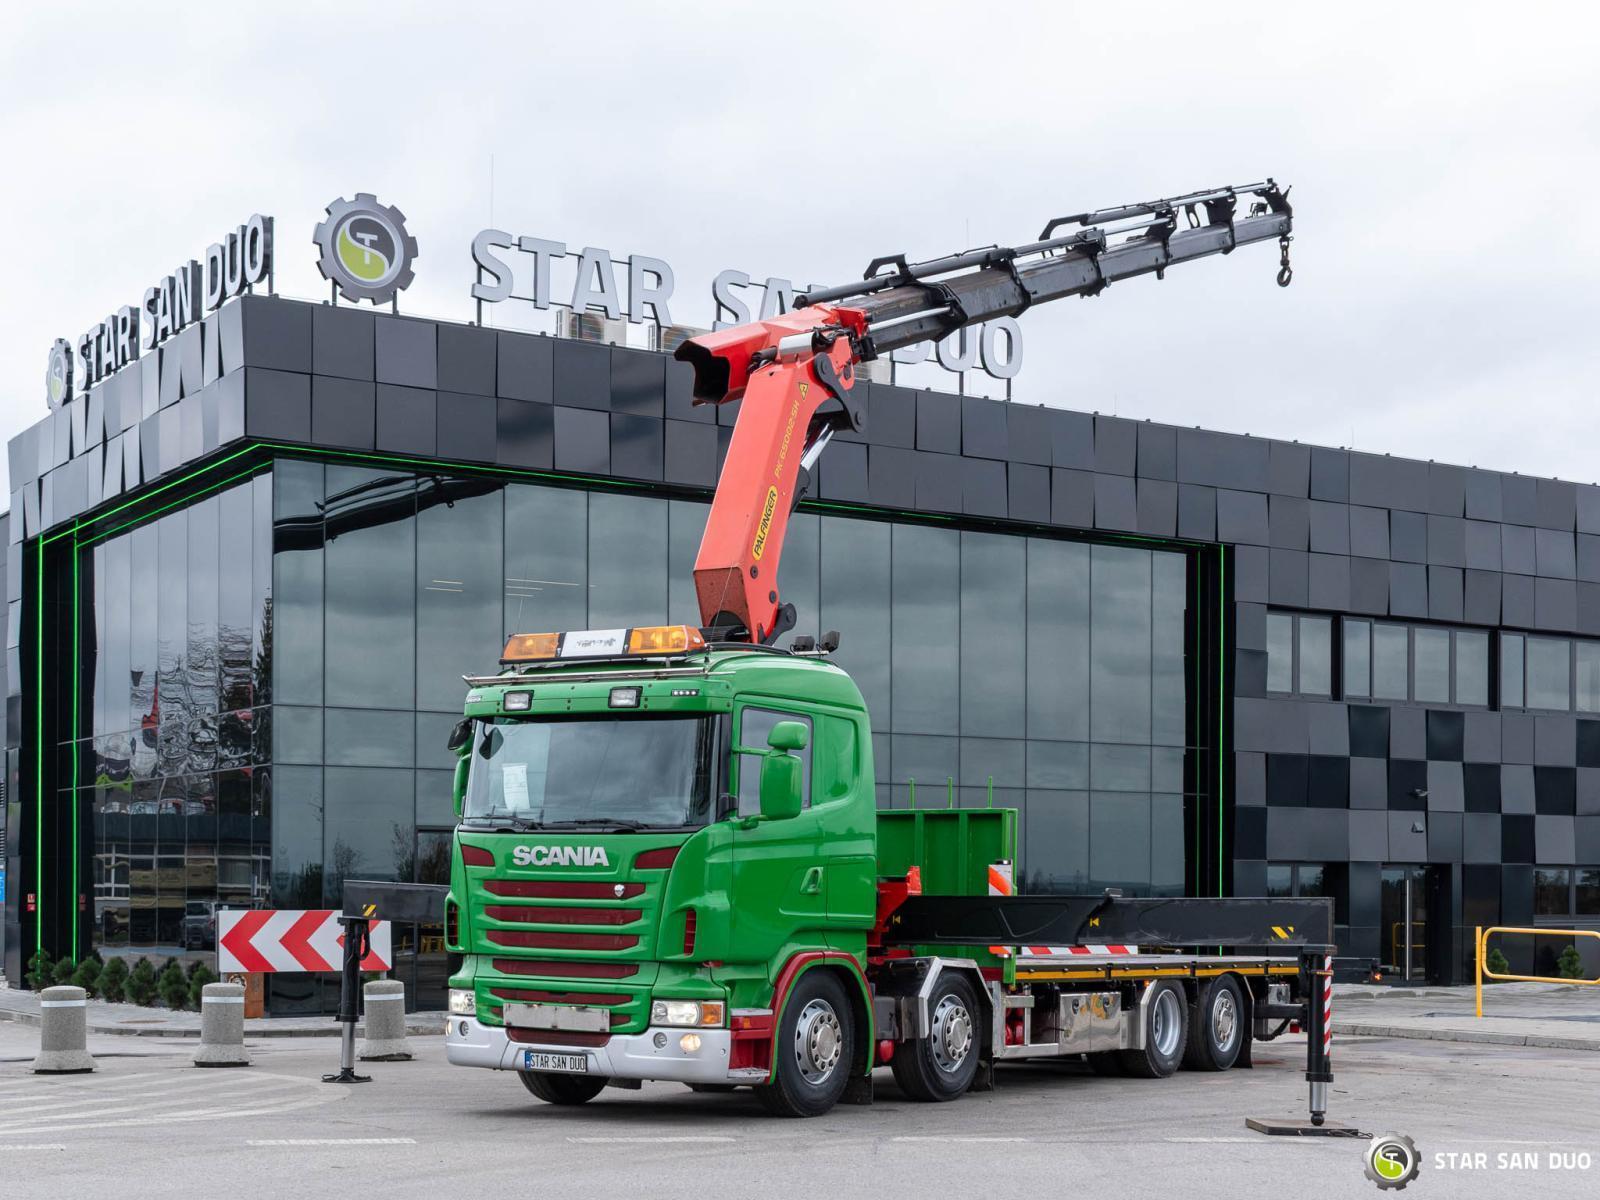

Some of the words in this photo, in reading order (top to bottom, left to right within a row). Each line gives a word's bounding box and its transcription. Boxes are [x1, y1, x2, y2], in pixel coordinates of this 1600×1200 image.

[77, 304, 140, 391] STAR
[143, 259, 202, 350] SAN
[206, 213, 271, 311] DUO
[471, 228, 675, 329] STAR
[712, 269, 832, 333] SA
[753, 490, 777, 556] PALFINGER
[512, 845, 610, 867] SCANIA
[530, 1054, 549, 1068] STAR
[551, 1056, 567, 1069] SAN
[569, 1057, 586, 1071] DUO
